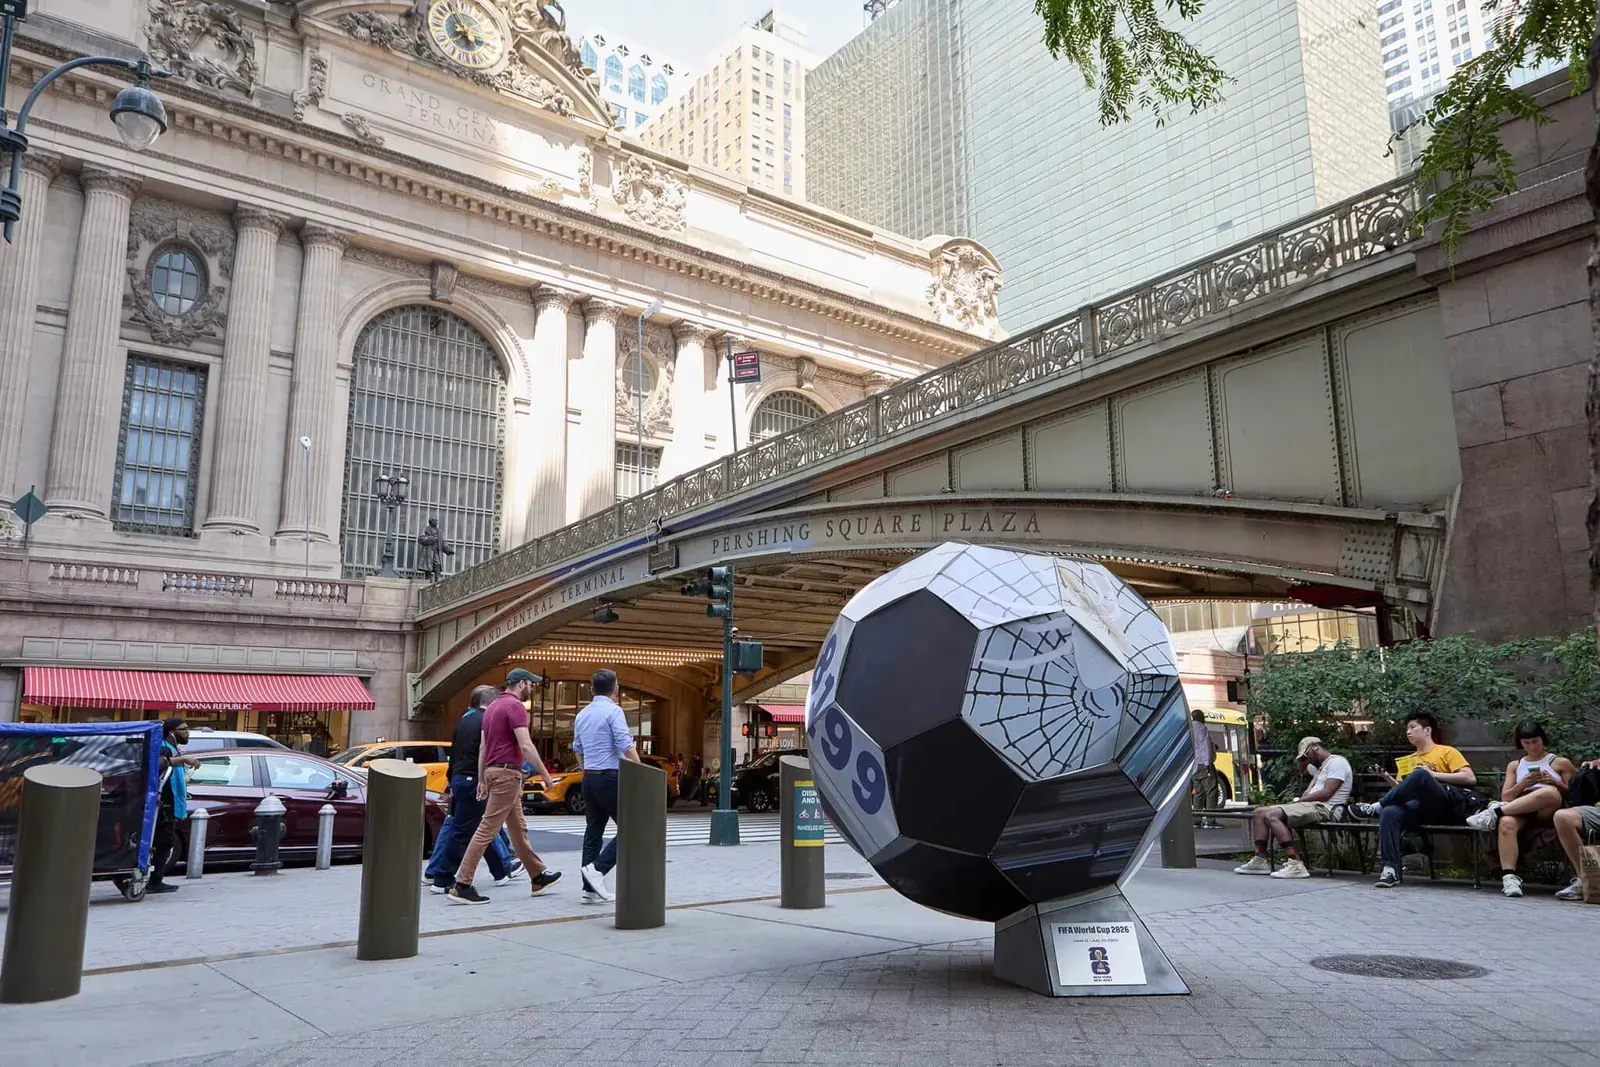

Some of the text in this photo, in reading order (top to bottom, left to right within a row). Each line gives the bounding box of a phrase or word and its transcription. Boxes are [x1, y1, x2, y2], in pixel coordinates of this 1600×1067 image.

[362, 73, 441, 110] GRAND
[712, 511, 1041, 554] PERSHING SQUARE PLAZA
[470, 567, 625, 655] GRAND CENTRAL TERMINAL
[1058, 926, 1130, 935] FIFA World Cup 2026
